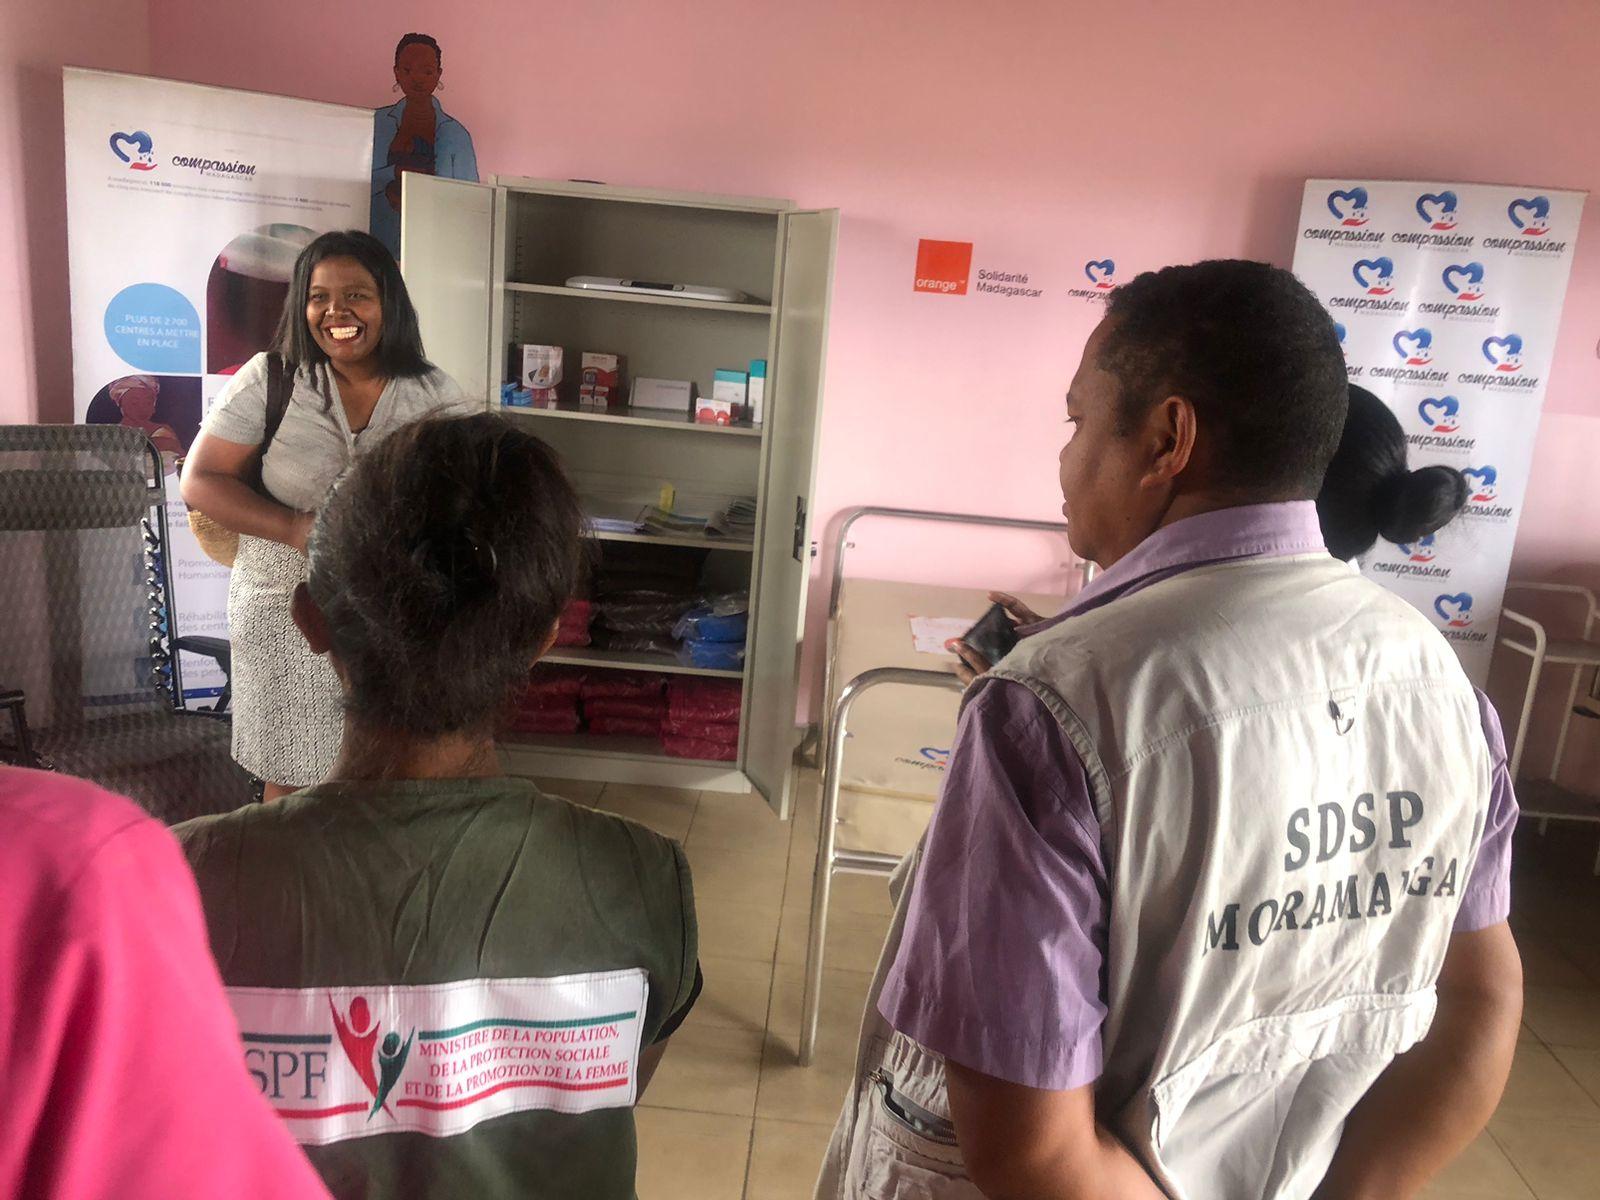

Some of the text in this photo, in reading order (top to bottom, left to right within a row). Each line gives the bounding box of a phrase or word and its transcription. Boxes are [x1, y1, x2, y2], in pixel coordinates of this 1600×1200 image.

[172, 155, 256, 175] compassion
[1303, 228, 1385, 246] compassion
[1391, 232, 1474, 250] compassion
[1482, 238, 1566, 255] compassion
[916, 278, 957, 292] orange
[978, 269, 1029, 284] Solidarité
[976, 282, 1043, 297] Madagascar
[1329, 297, 1410, 313] compassion
[1417, 302, 1500, 319] compassion
[1369, 367, 1449, 384] compassion
[1457, 373, 1539, 390] compassion
[1372, 562, 1452, 578] compassion
[1284, 790, 1424, 872] SDSP
[1202, 856, 1458, 958] MORAMAGA
[492, 1028, 510, 1041] DE
[513, 1029, 530, 1041] LA
[534, 1024, 620, 1043] POPULATION,
[430, 1045, 610, 1078] DE LA PROTECTION SOCIALE
[405, 1060, 629, 1098] ET DE LA PROMOTION DE LA FEMME
